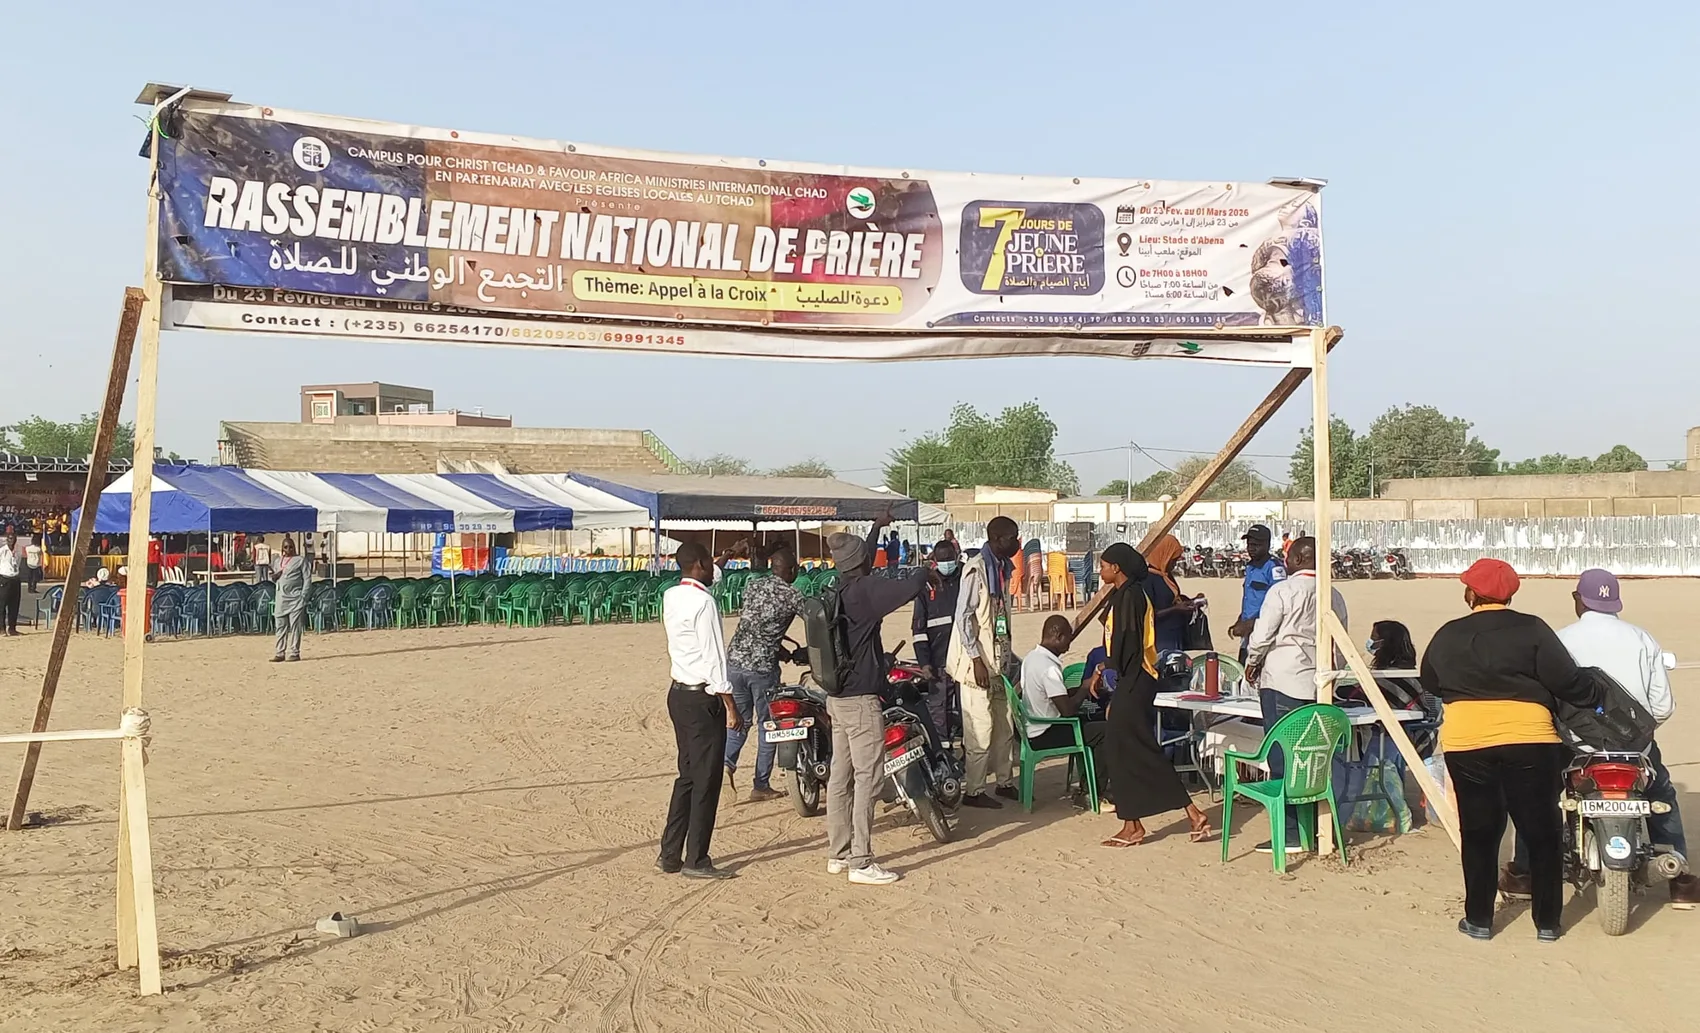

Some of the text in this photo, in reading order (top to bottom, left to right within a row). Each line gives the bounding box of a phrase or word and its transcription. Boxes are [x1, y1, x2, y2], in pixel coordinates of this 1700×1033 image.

[347, 147, 828, 199] CAMPUS POUR CHRIST TCHAD & FAVOUR AFRICA MINISTRIES INTERNATIONAL CHAD
[435, 170, 754, 207] EN PARTENARIAT AVEC LES EGLISES LOCALES AU TCHAD
[575, 197, 641, 211] Présente
[1140, 206, 1249, 217] Du 23 Fev. au 01 Mars 2026
[1021, 220, 1073, 231] JOURS DE
[1140, 216, 1158, 225] 2026
[1160, 217, 1180, 226] مارس
[1196, 217, 1215, 228] فبراير
[1216, 218, 1226, 226] 23
[203, 176, 925, 279] RASSEMBLEMENT NATIONAL DE PRIÈRE
[1008, 231, 1078, 254] JEÛNE
[1139, 235, 1225, 245] Lieu: Stade d'Abena
[979, 207, 1026, 291] 7
[1154, 247, 1176, 258] ملعب
[268, 239, 564, 303] التجمع الوطني للصلاة
[1140, 269, 1208, 278] De 7H00 à 18H00
[1004, 273, 1090, 290] أيام الصيام والصلاة
[1163, 280, 1181, 288] 7:00
[1182, 280, 1206, 289] الساعة
[1208, 282, 1218, 290] من
[584, 277, 768, 302] Thème: Appel à la Croix
[1166, 290, 1182, 299] 6:00
[1183, 290, 1208, 299] الساعة
[213, 284, 238, 300] Du
[243, 288, 267, 302] 23
[344, 298, 366, 307] au
[797, 289, 889, 309] دعوة للصليب
[241, 313, 321, 328] Contact
[329, 319, 335, 328] :
[343, 318, 405, 333] (+235)
[1023, 315, 1045, 323] +235
[1063, 315, 1074, 323] 25
[1290, 751, 1328, 789] MP
